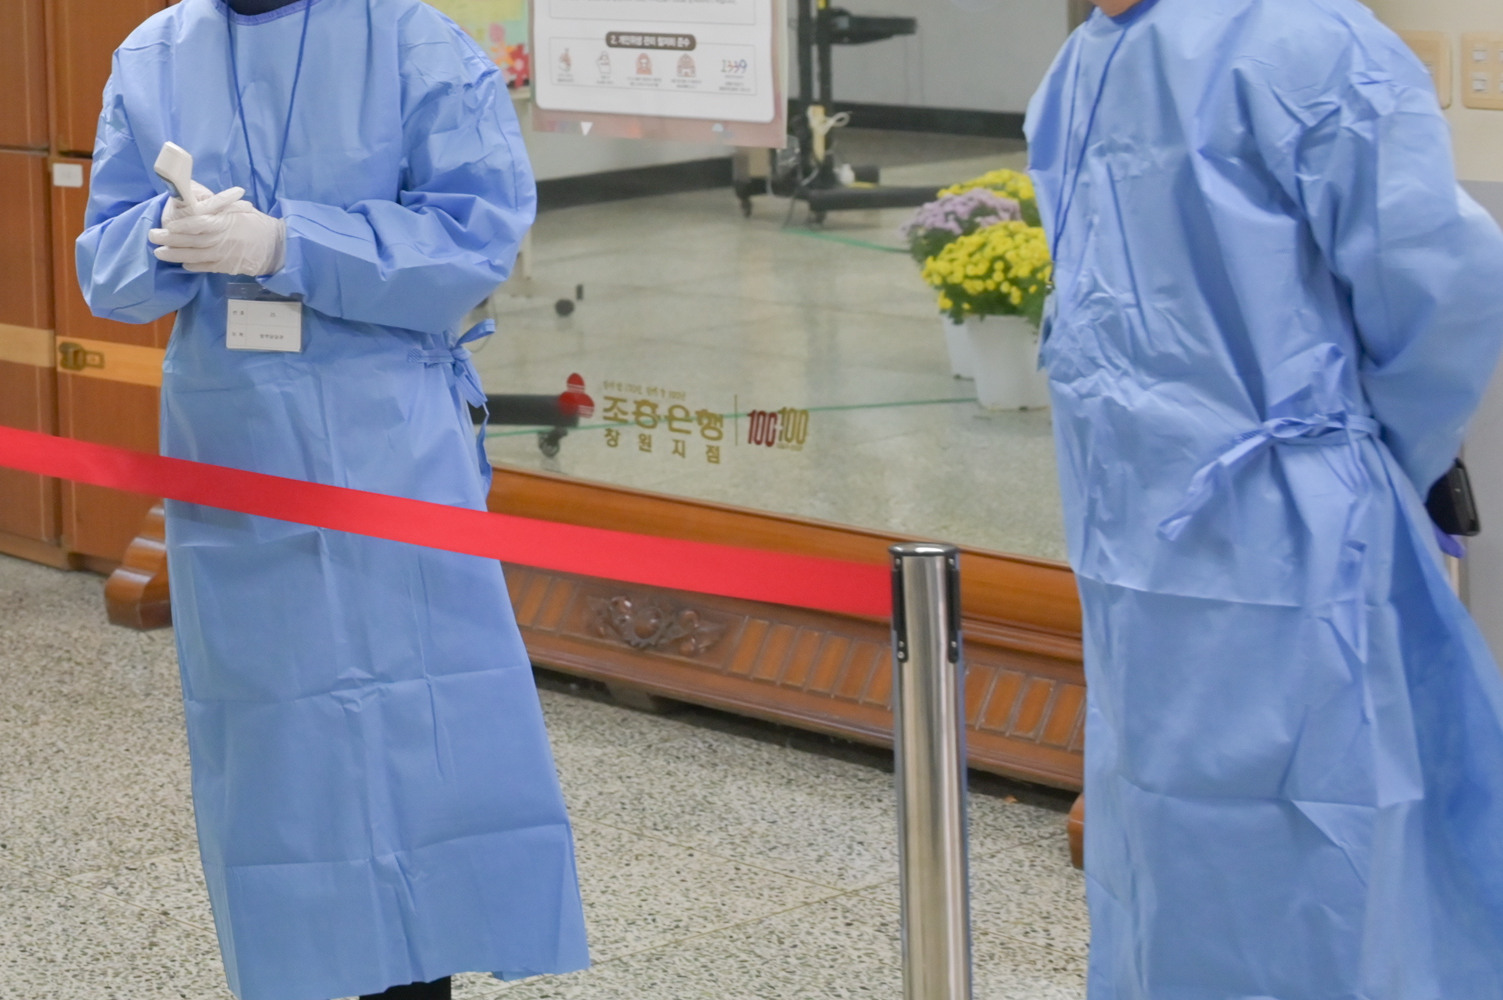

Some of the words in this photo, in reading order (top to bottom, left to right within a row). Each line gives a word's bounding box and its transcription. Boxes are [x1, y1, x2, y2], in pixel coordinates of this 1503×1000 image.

[721, 59, 748, 73] 1339
[603, 396, 724, 441] 조흥은행
[604, 428, 720, 464] 창원지점
